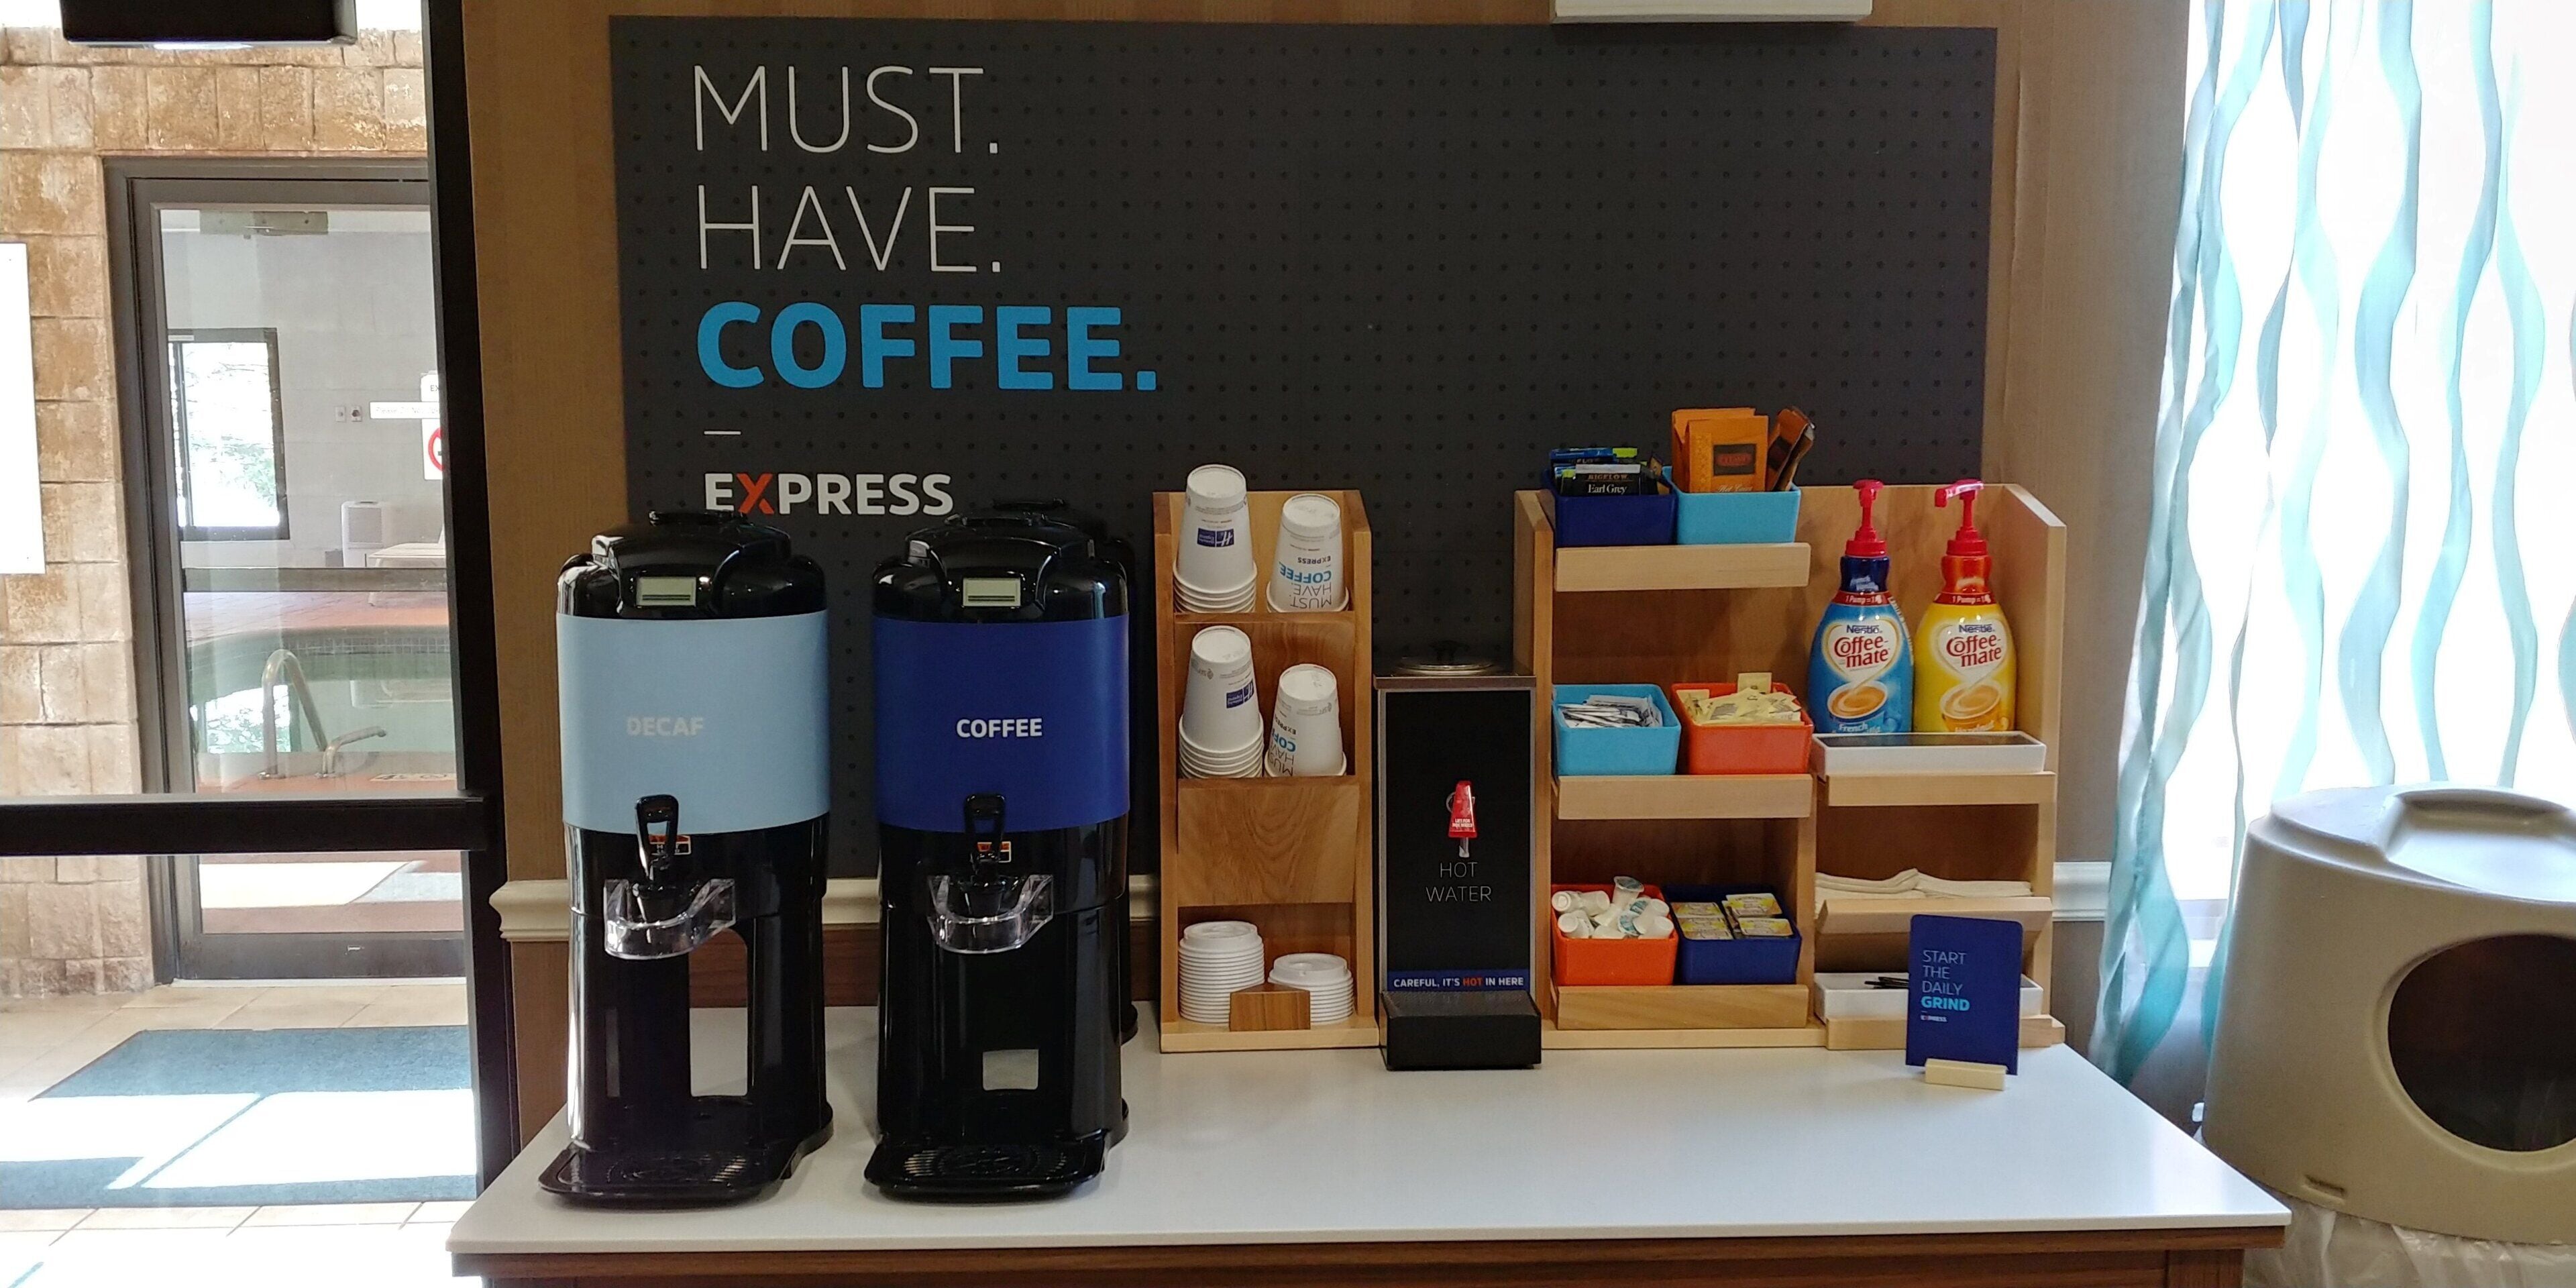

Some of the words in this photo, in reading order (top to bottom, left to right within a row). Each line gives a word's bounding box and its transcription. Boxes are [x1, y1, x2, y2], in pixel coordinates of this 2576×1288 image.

[694, 65, 998, 154] MUST.
[698, 184, 1001, 272] HAVE.
[697, 301, 1157, 390] COFFEE.
[704, 473, 954, 515] EXPRESS
[1588, 484, 1605, 493] Earl
[1607, 484, 1627, 495] Grey
[1297, 555, 1331, 564] EXPRESS
[1291, 582, 1332, 596] HAVE.
[1289, 594, 1332, 609] MUST.
[1846, 649, 1888, 667] mate
[1961, 647, 2002, 667] mate
[627, 716, 704, 737] DECAF
[956, 718, 1043, 738] COFFEE
[1839, 722, 1868, 732] French
[1440, 861, 1477, 878] HOT
[1426, 885, 1492, 902] WATER
[1923, 950, 1967, 965] START
[1923, 965, 1950, 979] THE
[1393, 979, 1440, 988] CAREFUL,
[1442, 978, 1460, 987] IT'S
[1462, 977, 1483, 986] HOT
[1485, 977, 1496, 986] IN
[1498, 977, 1524, 986] HERE
[1922, 981, 1963, 996] DAILY
[1921, 996, 1970, 1011] GRIND
